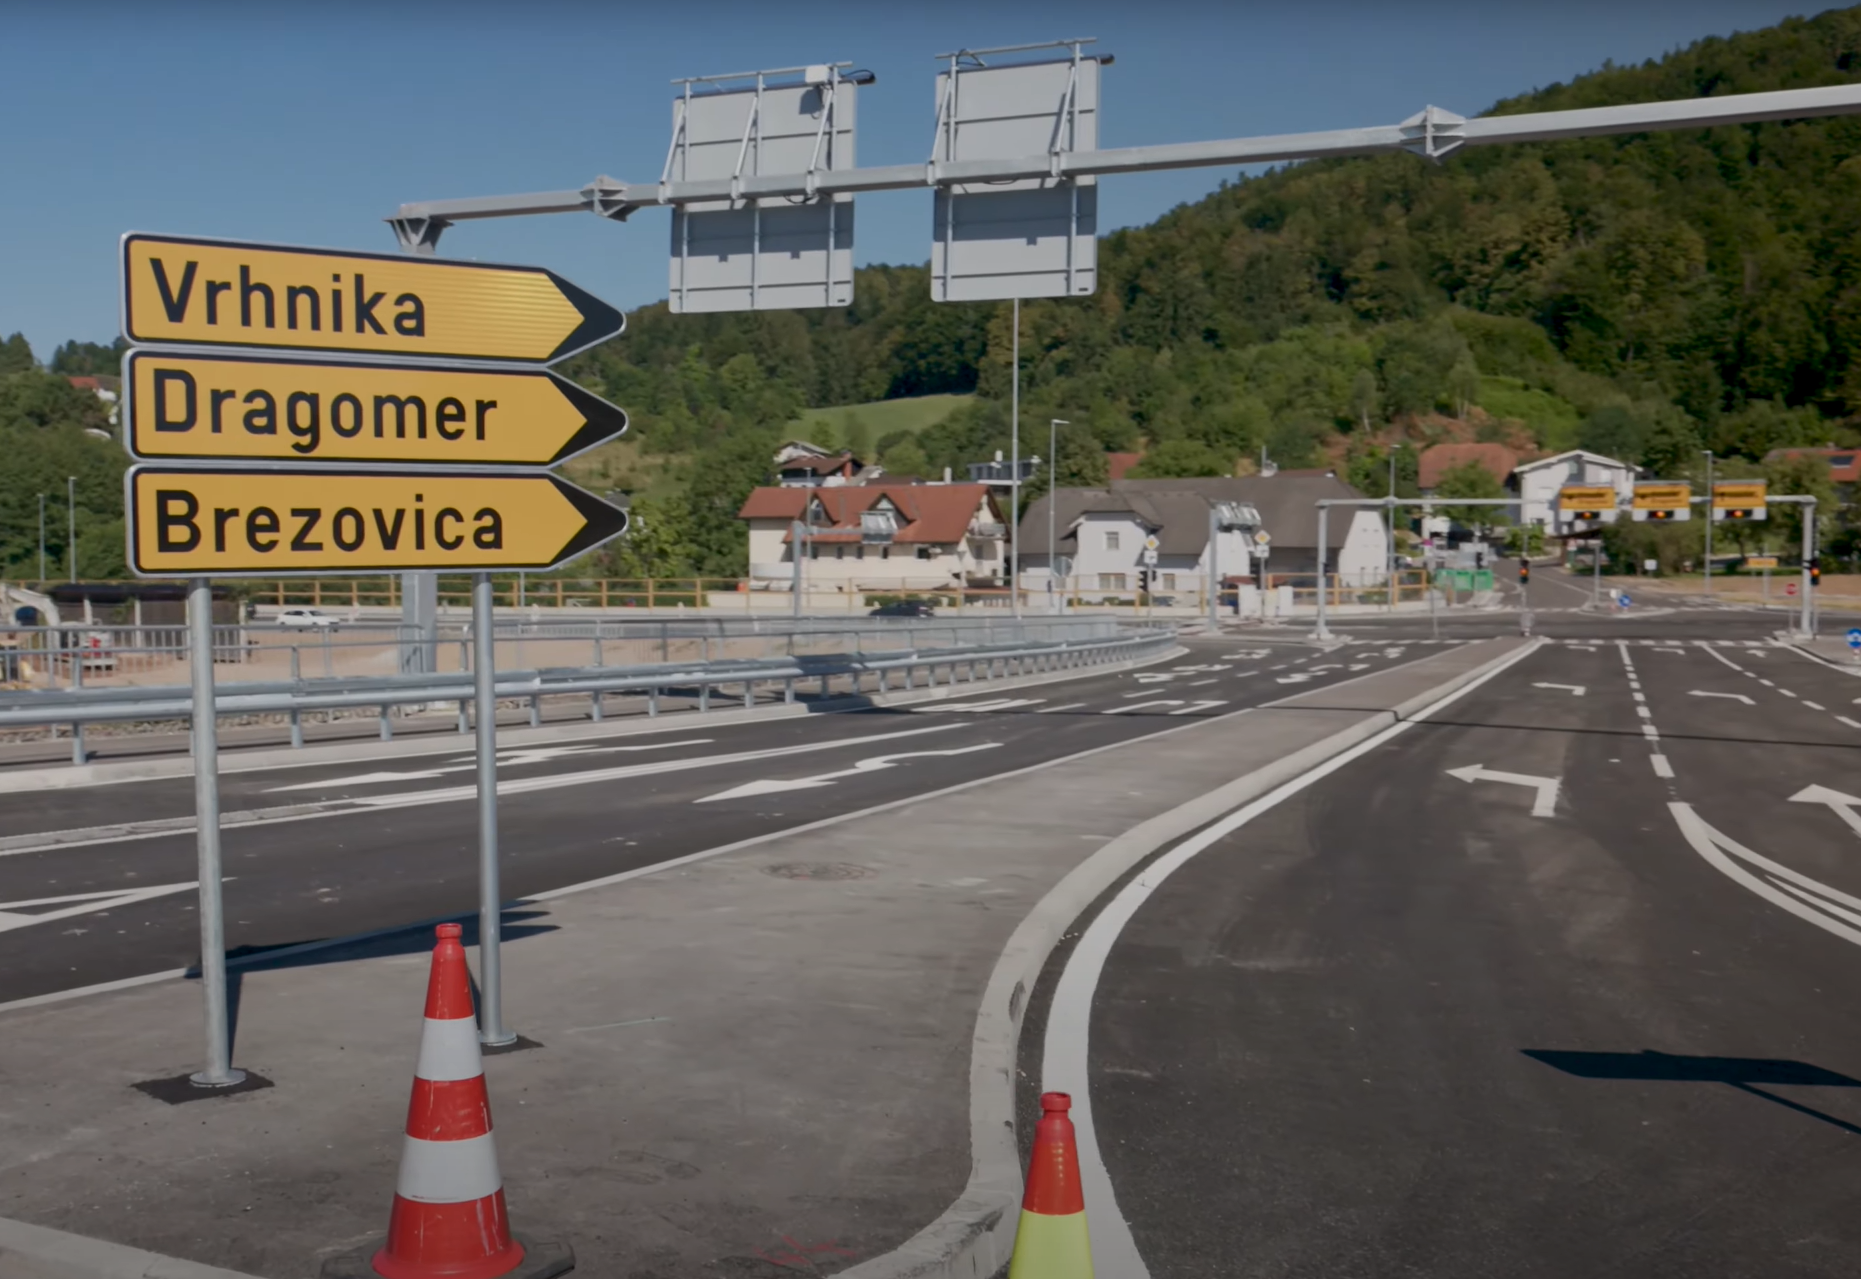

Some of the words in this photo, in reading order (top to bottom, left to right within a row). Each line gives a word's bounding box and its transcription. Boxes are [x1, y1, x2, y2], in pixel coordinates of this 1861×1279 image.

[149, 258, 426, 337] Vrhnika
[153, 368, 498, 454] Dragomer
[156, 489, 503, 554] Brezovica
